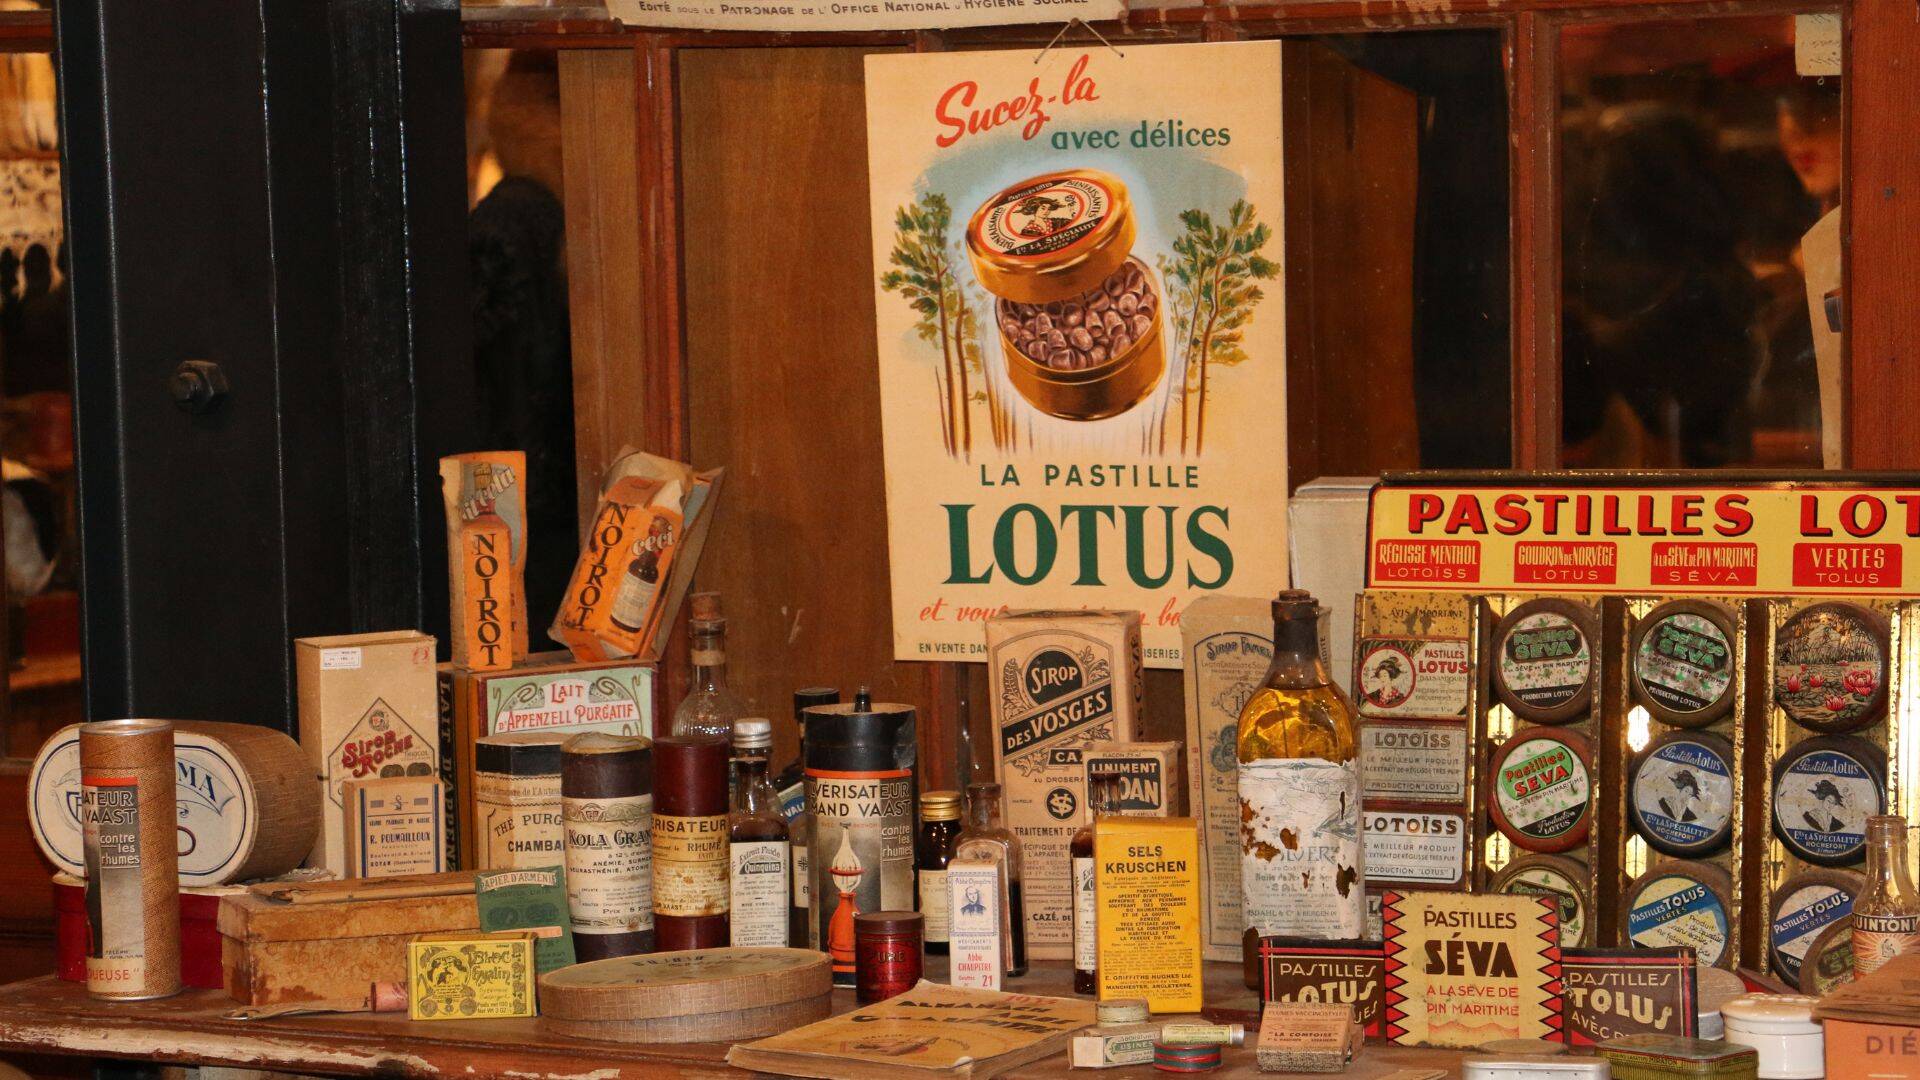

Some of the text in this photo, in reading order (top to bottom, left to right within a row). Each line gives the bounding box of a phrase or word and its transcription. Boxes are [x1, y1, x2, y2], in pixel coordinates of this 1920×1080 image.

[720, 4, 795, 15] PATRONAGE
[831, 3, 879, 15] OFFICE
[885, 1, 950, 13] NATIONAL
[1051, 120, 1231, 150] avec délices
[980, 464, 1200, 488] LA PASTILLE
[1408, 493, 1754, 537] PASTILLES
[940, 503, 1235, 590] LOTUS
[1379, 542, 1478, 565] RÉGLISSE MENTHOL
[1518, 546, 1564, 566] GOUDRON
[1713, 547, 1756, 568] MARITIME
[1812, 548, 1885, 569] VERTES
[574, 500, 633, 632] NOIROT
[1388, 566, 1467, 579] LOTOÏSS
[1533, 570, 1600, 580] LOTUS
[1669, 570, 1740, 582] SÉVA
[1816, 573, 1880, 584] TOLUS
[473, 533, 501, 667] NOIROT
[920, 598, 948, 621] et
[919, 643, 931, 653] EN
[935, 643, 966, 654] VENTE
[1425, 649, 1465, 659] PASTILLES
[1419, 661, 1469, 673] LOTUS
[1031, 666, 1078, 694] SIROP
[551, 683, 585, 704] LAIT
[1553, 690, 1574, 698] LOTUS
[499, 710, 572, 732] D'APPENZELL
[1006, 691, 1108, 750] DES VOSGES
[1375, 731, 1451, 748] LOTOÏSS
[1055, 752, 1083, 762] CA
[1092, 763, 1157, 773] LINIMENT
[1514, 765, 1570, 797] SEVA
[85, 808, 137, 825] VAAST
[858, 800, 911, 817] VAAST
[881, 825, 910, 836] contre
[1014, 827, 1064, 837] TRAITEMENT
[1363, 816, 1457, 835] LOTOÏSS
[1543, 819, 1572, 835] LOTUS
[100, 832, 135, 845] contre
[898, 834, 910, 844] les
[117, 843, 135, 853] les
[882, 845, 912, 857] rhumes
[1128, 846, 1162, 857] SELS
[101, 854, 140, 867] rhumes
[1106, 860, 1186, 873] KRUSCHEN
[1663, 886, 1706, 910] TOLUS
[1805, 892, 1850, 917] TOLUS
[1424, 910, 1517, 929] PASTILLES
[1630, 905, 1666, 923] PASTILLES
[1774, 913, 1809, 934] PASTILLES
[1424, 932, 1518, 978] SÉVA
[1280, 963, 1376, 978] PASTILLES
[982, 974, 993, 987] 21
[1569, 973, 1671, 986] PASTILLES
[1440, 985, 1456, 996] LA
[1498, 987, 1519, 998] DE
[1427, 1003, 1519, 1016] PIN MARITIME
[1571, 987, 1673, 1030] TOLUS
[1866, 1030, 1919, 1056] DIÉ
